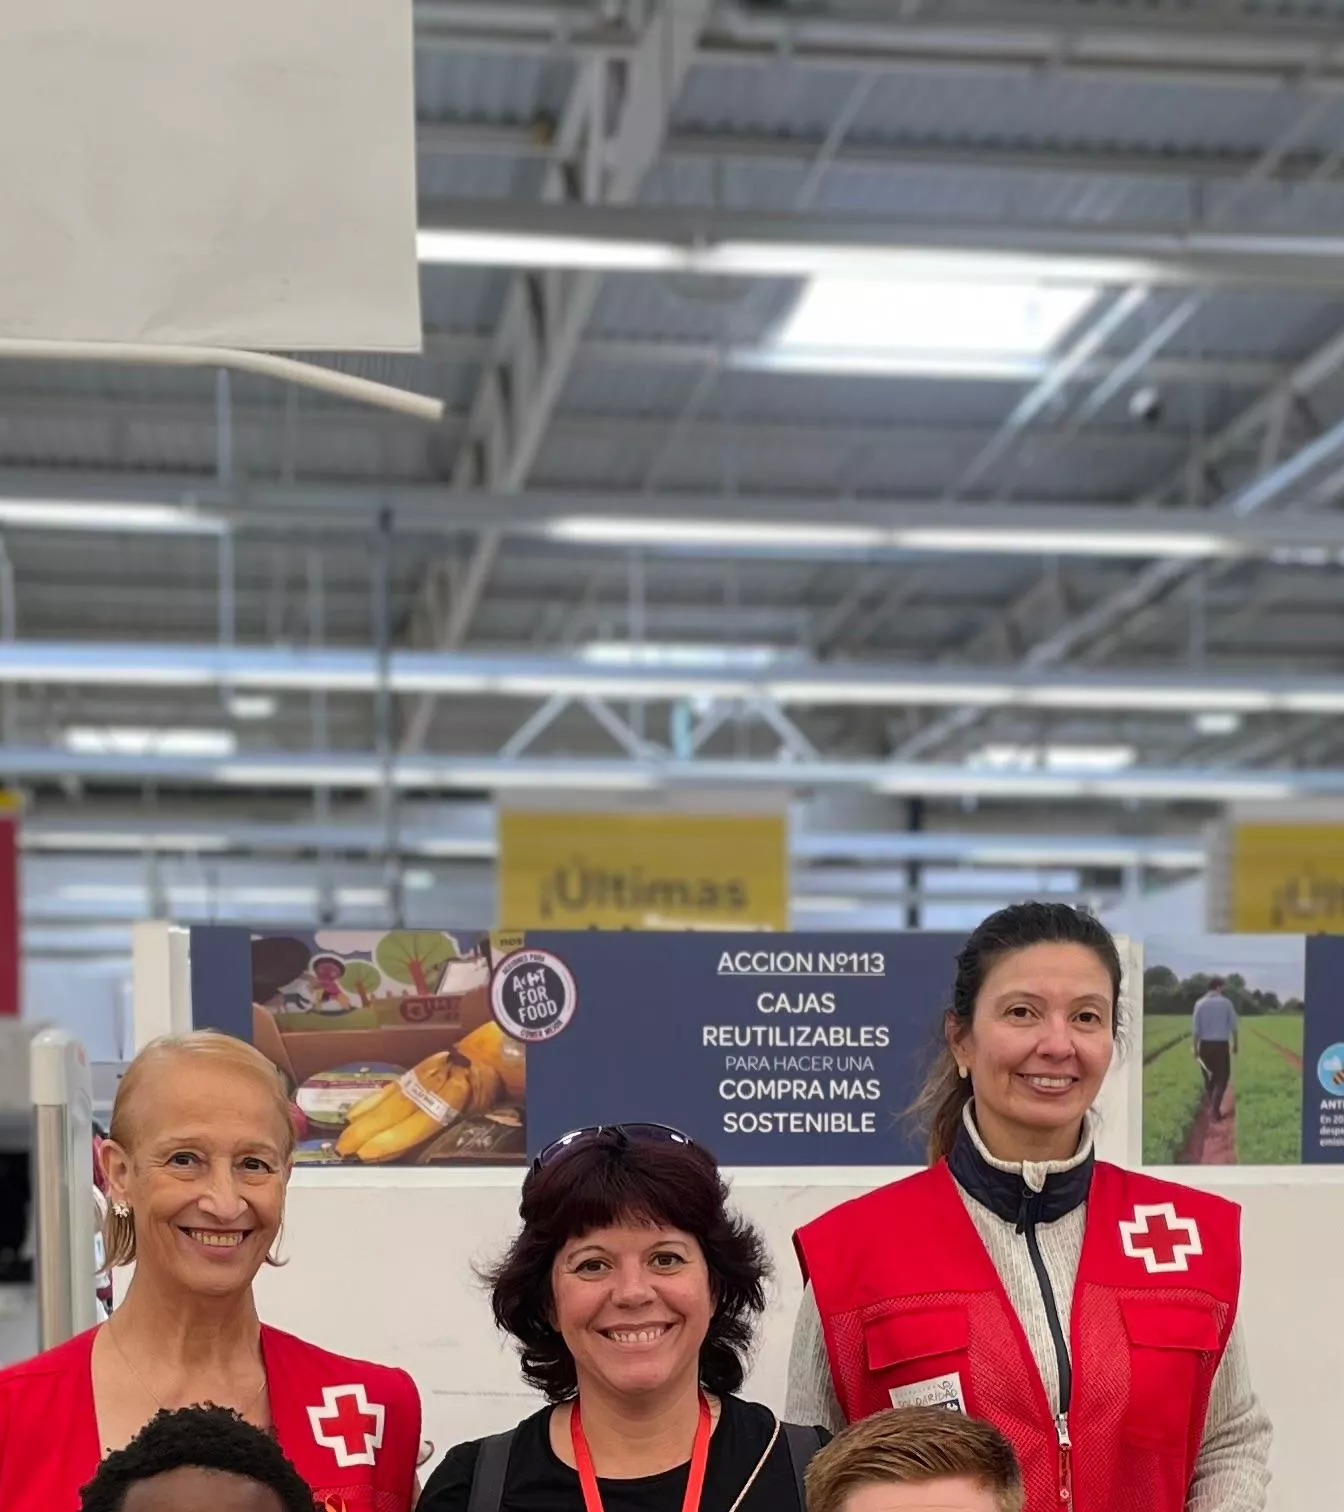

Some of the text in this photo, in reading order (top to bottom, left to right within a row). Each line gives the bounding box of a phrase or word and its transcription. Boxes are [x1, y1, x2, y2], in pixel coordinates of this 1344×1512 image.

[717, 952, 813, 973] ACCION
[519, 985, 549, 1006] FOR
[756, 992, 836, 1013] CAJAS
[518, 999, 558, 1024] FOOD
[702, 1026, 890, 1047] REUTILIZABLES
[725, 1056, 874, 1072] PARA HACER UNA
[719, 1080, 881, 1100] COMPRA MAS
[723, 1112, 876, 1133] SOSTENIBLE
